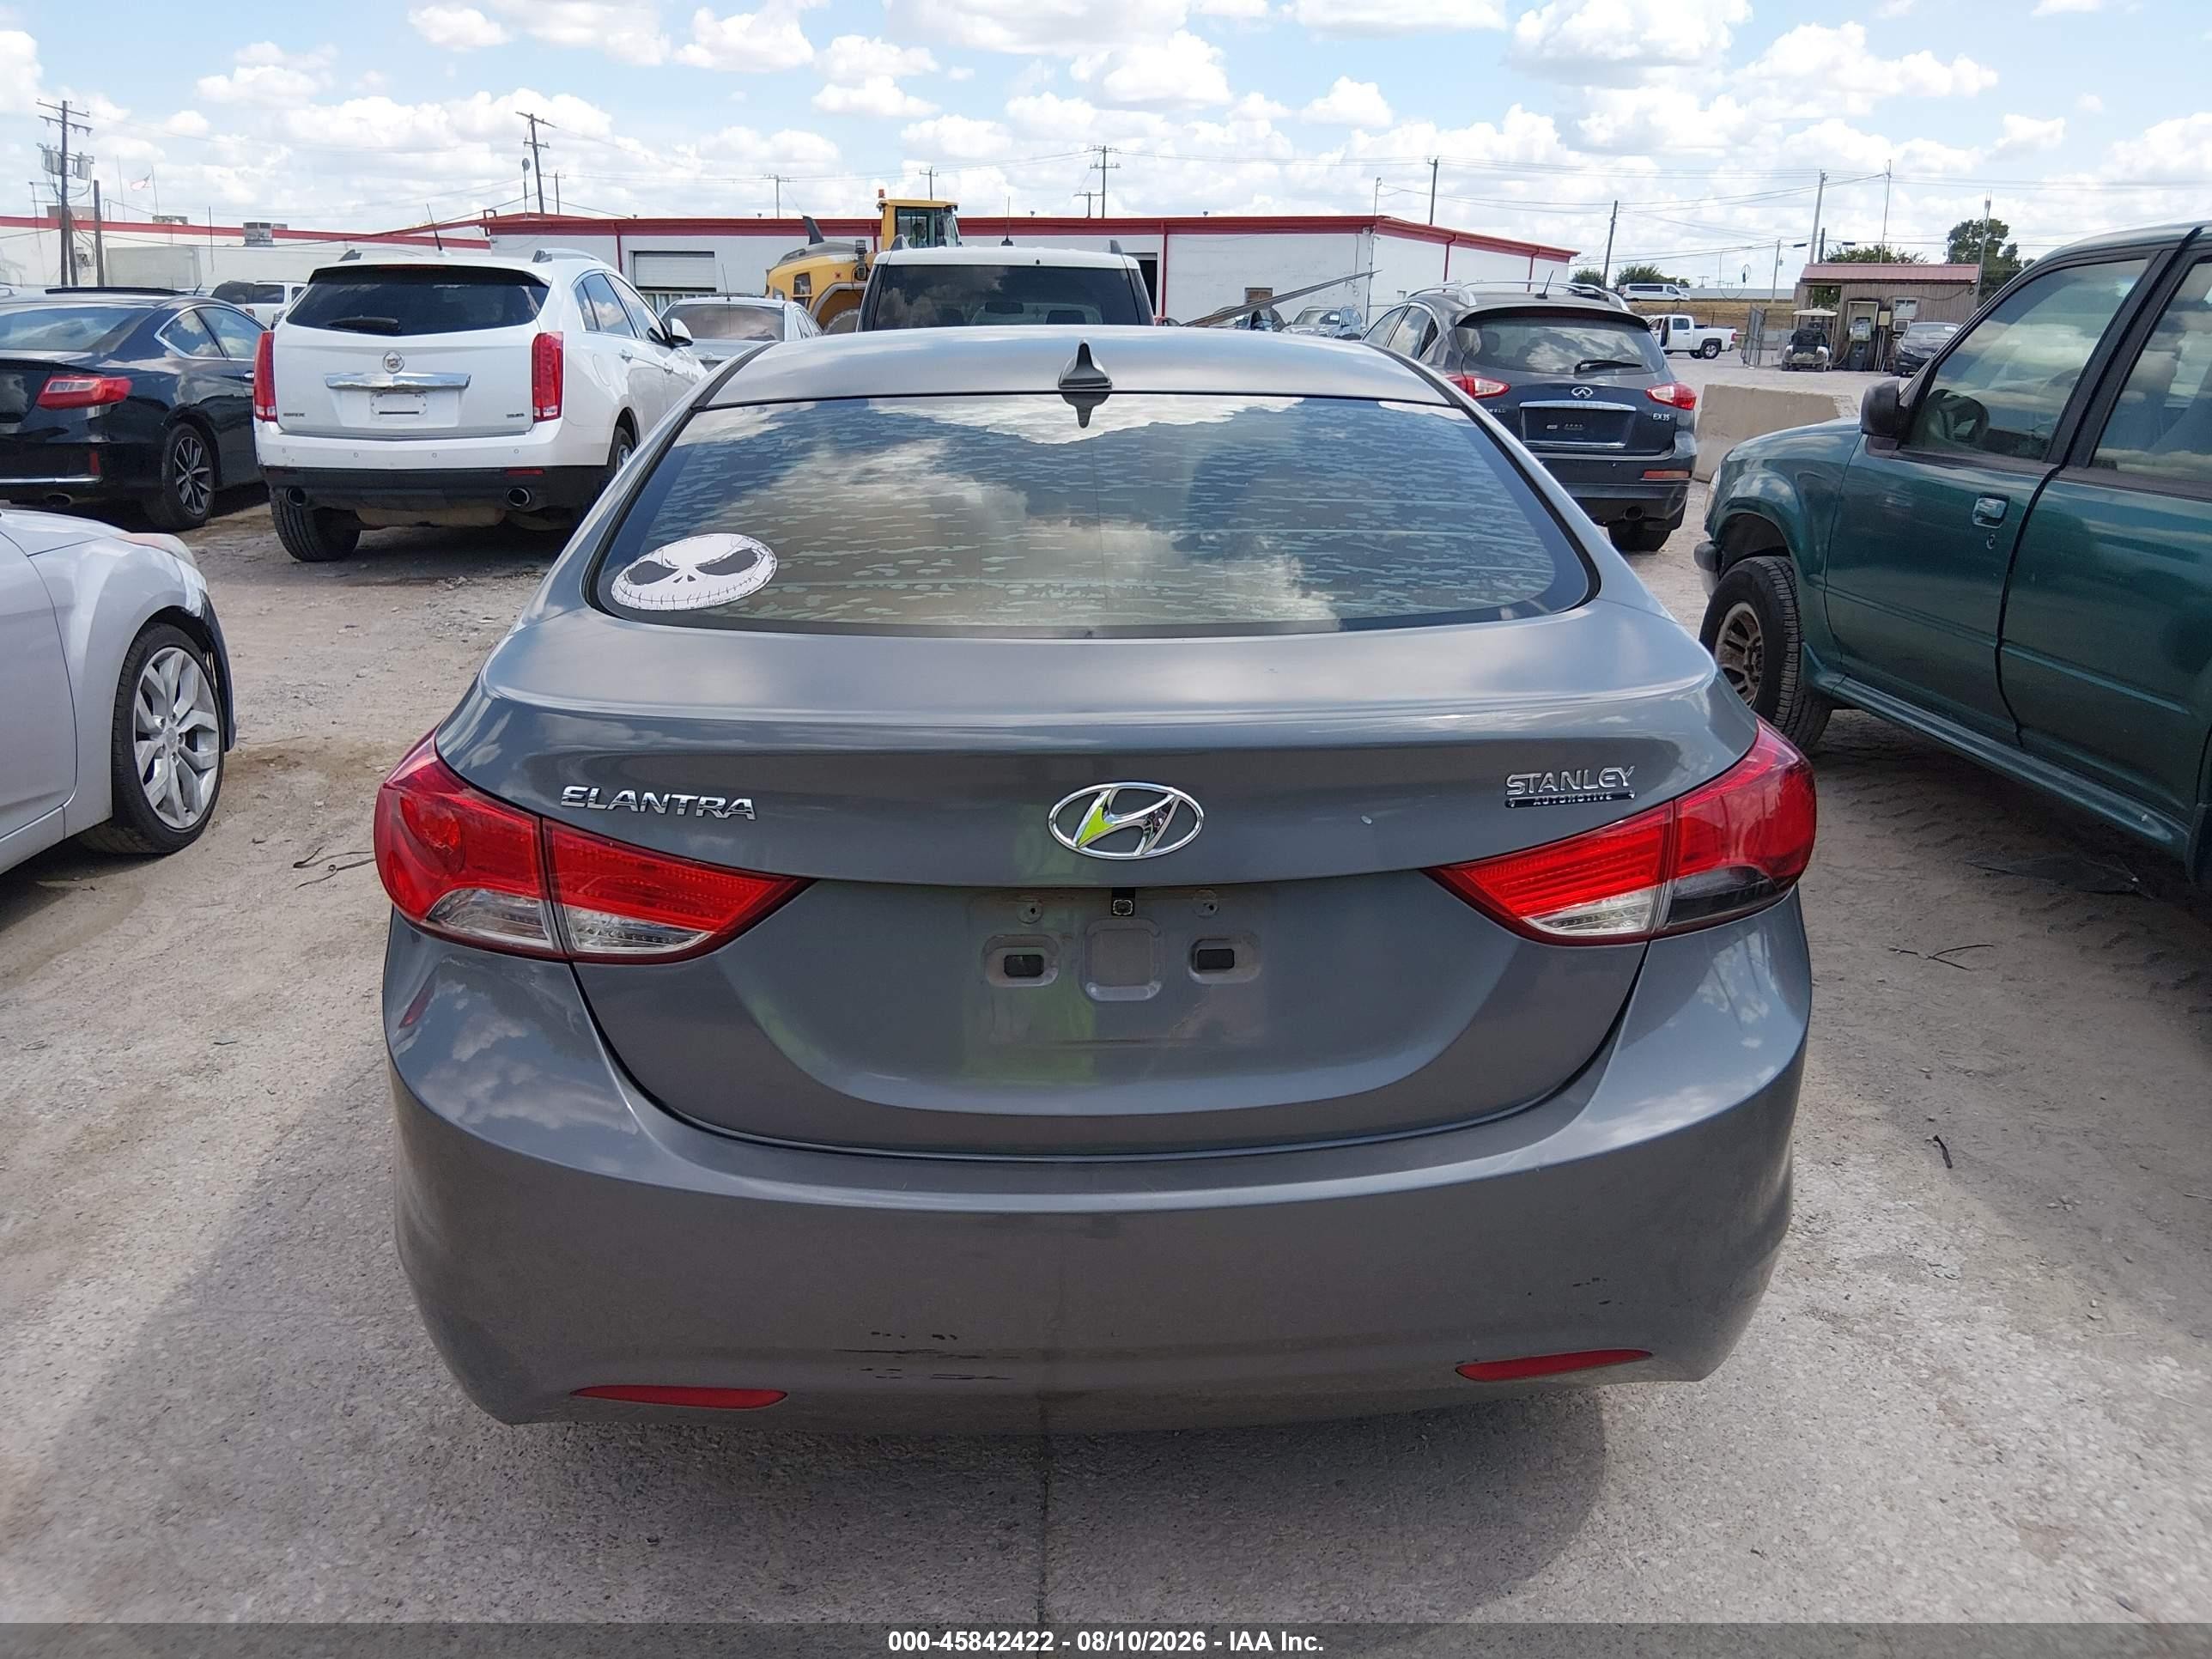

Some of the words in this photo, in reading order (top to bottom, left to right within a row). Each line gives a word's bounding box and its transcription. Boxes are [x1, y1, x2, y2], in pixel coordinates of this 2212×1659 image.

[1652, 412, 1671, 422] EX35
[1505, 766, 1636, 796] STANLEY
[561, 785, 757, 821] ELANTRA
[1533, 792, 1613, 806] AUTOMOTIVE
